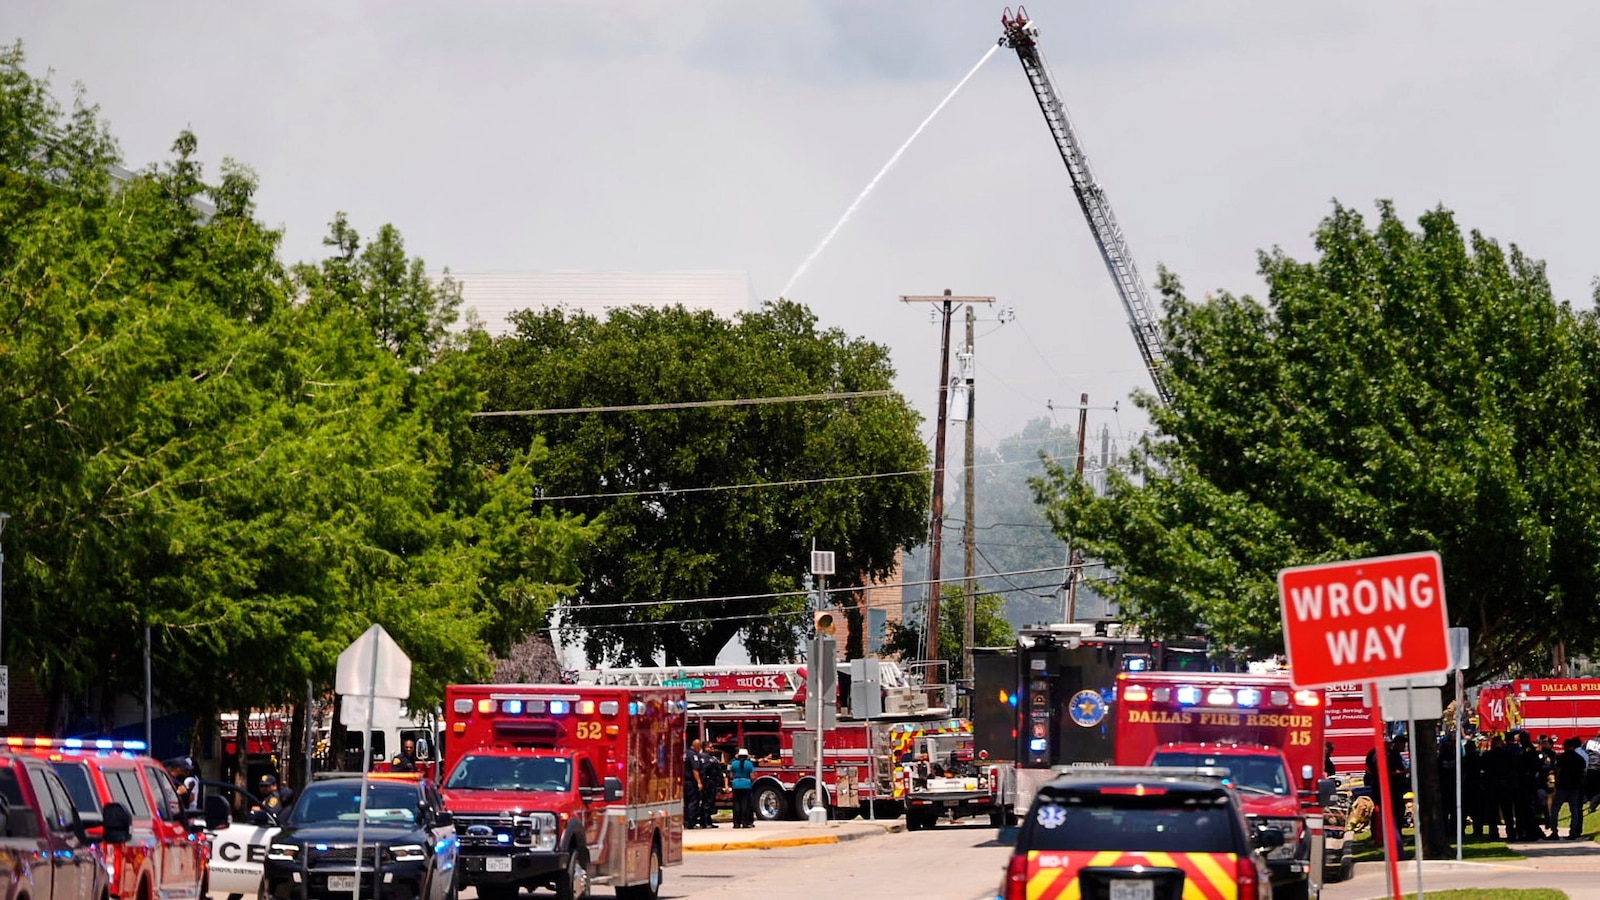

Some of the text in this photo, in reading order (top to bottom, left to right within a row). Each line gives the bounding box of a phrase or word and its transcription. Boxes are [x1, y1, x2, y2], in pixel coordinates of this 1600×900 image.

[1290, 572, 1434, 622] WRONG
[1325, 623, 1406, 666] WAY
[736, 675, 780, 689] TRUCK
[1541, 683, 1578, 692] DALLAS
[1128, 709, 1313, 728] DALLAS FIRE RESCUE
[1488, 699, 1504, 722] 14
[227, 720, 266, 729] RECUE
[576, 721, 602, 740] 52
[1289, 730, 1312, 746] 15
[1038, 855, 1069, 868] MD-1
[233, 868, 262, 876] DISTRICT
